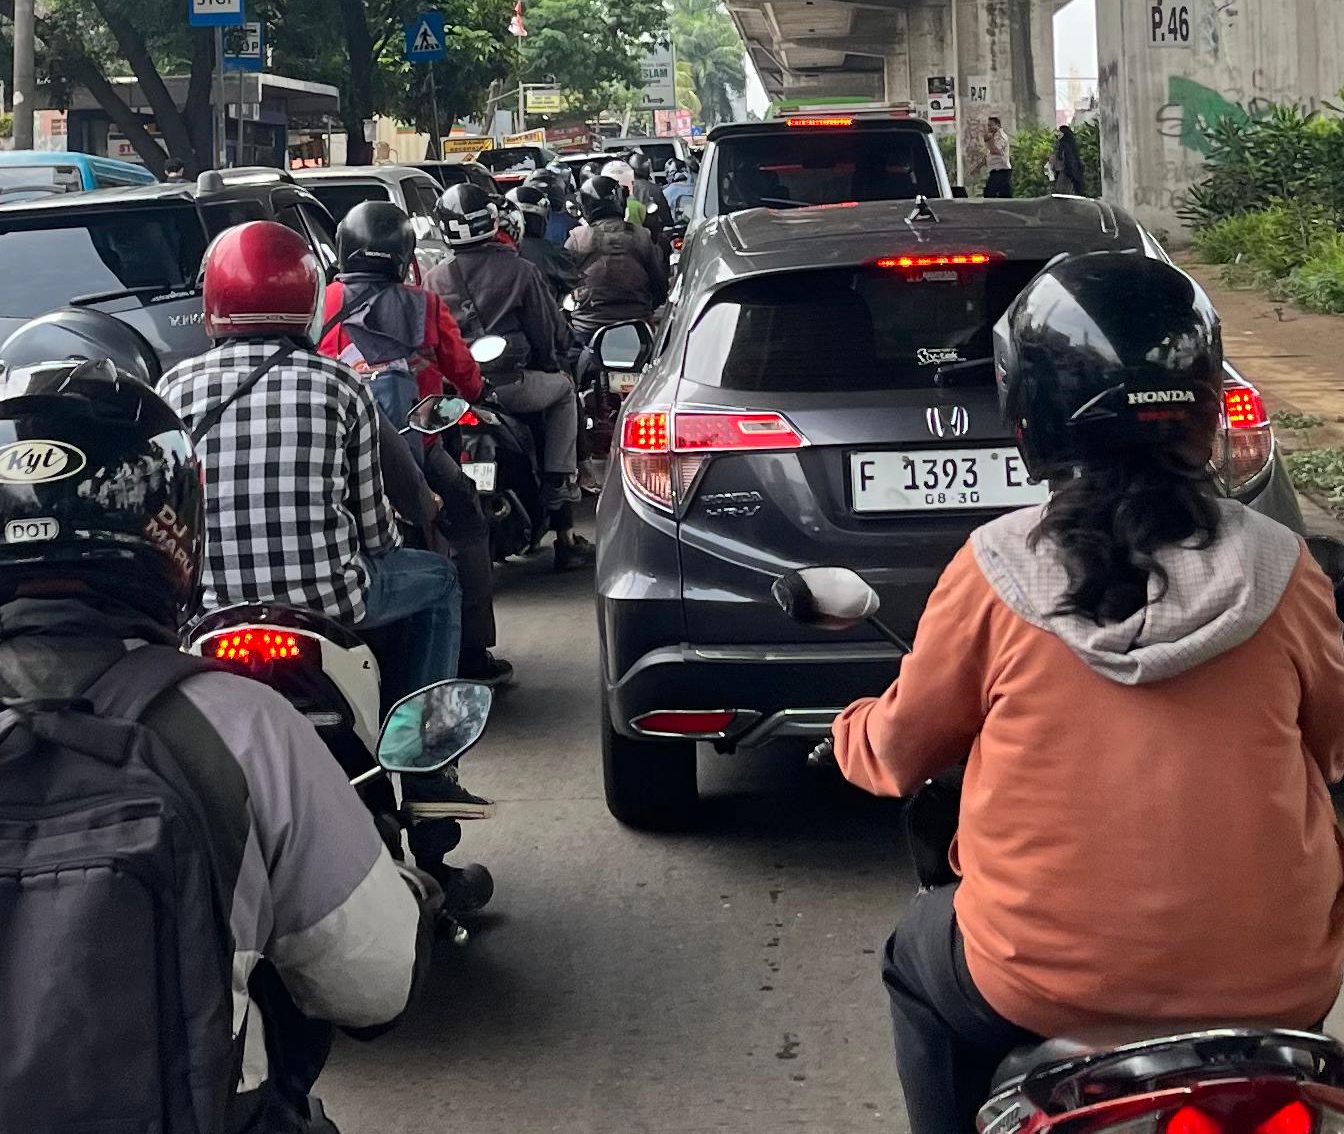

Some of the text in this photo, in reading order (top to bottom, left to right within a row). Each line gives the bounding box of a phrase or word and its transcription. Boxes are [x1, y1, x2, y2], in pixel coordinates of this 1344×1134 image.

[1150, 5, 1190, 43] P.46
[643, 68, 668, 79] SLAM
[970, 86, 987, 102] P.47
[1127, 390, 1196, 405] HONDA
[860, 460, 875, 492] F
[904, 457, 978, 491] 1393
[924, 491, 980, 506] 08 30
[11, 522, 51, 540] DOT
